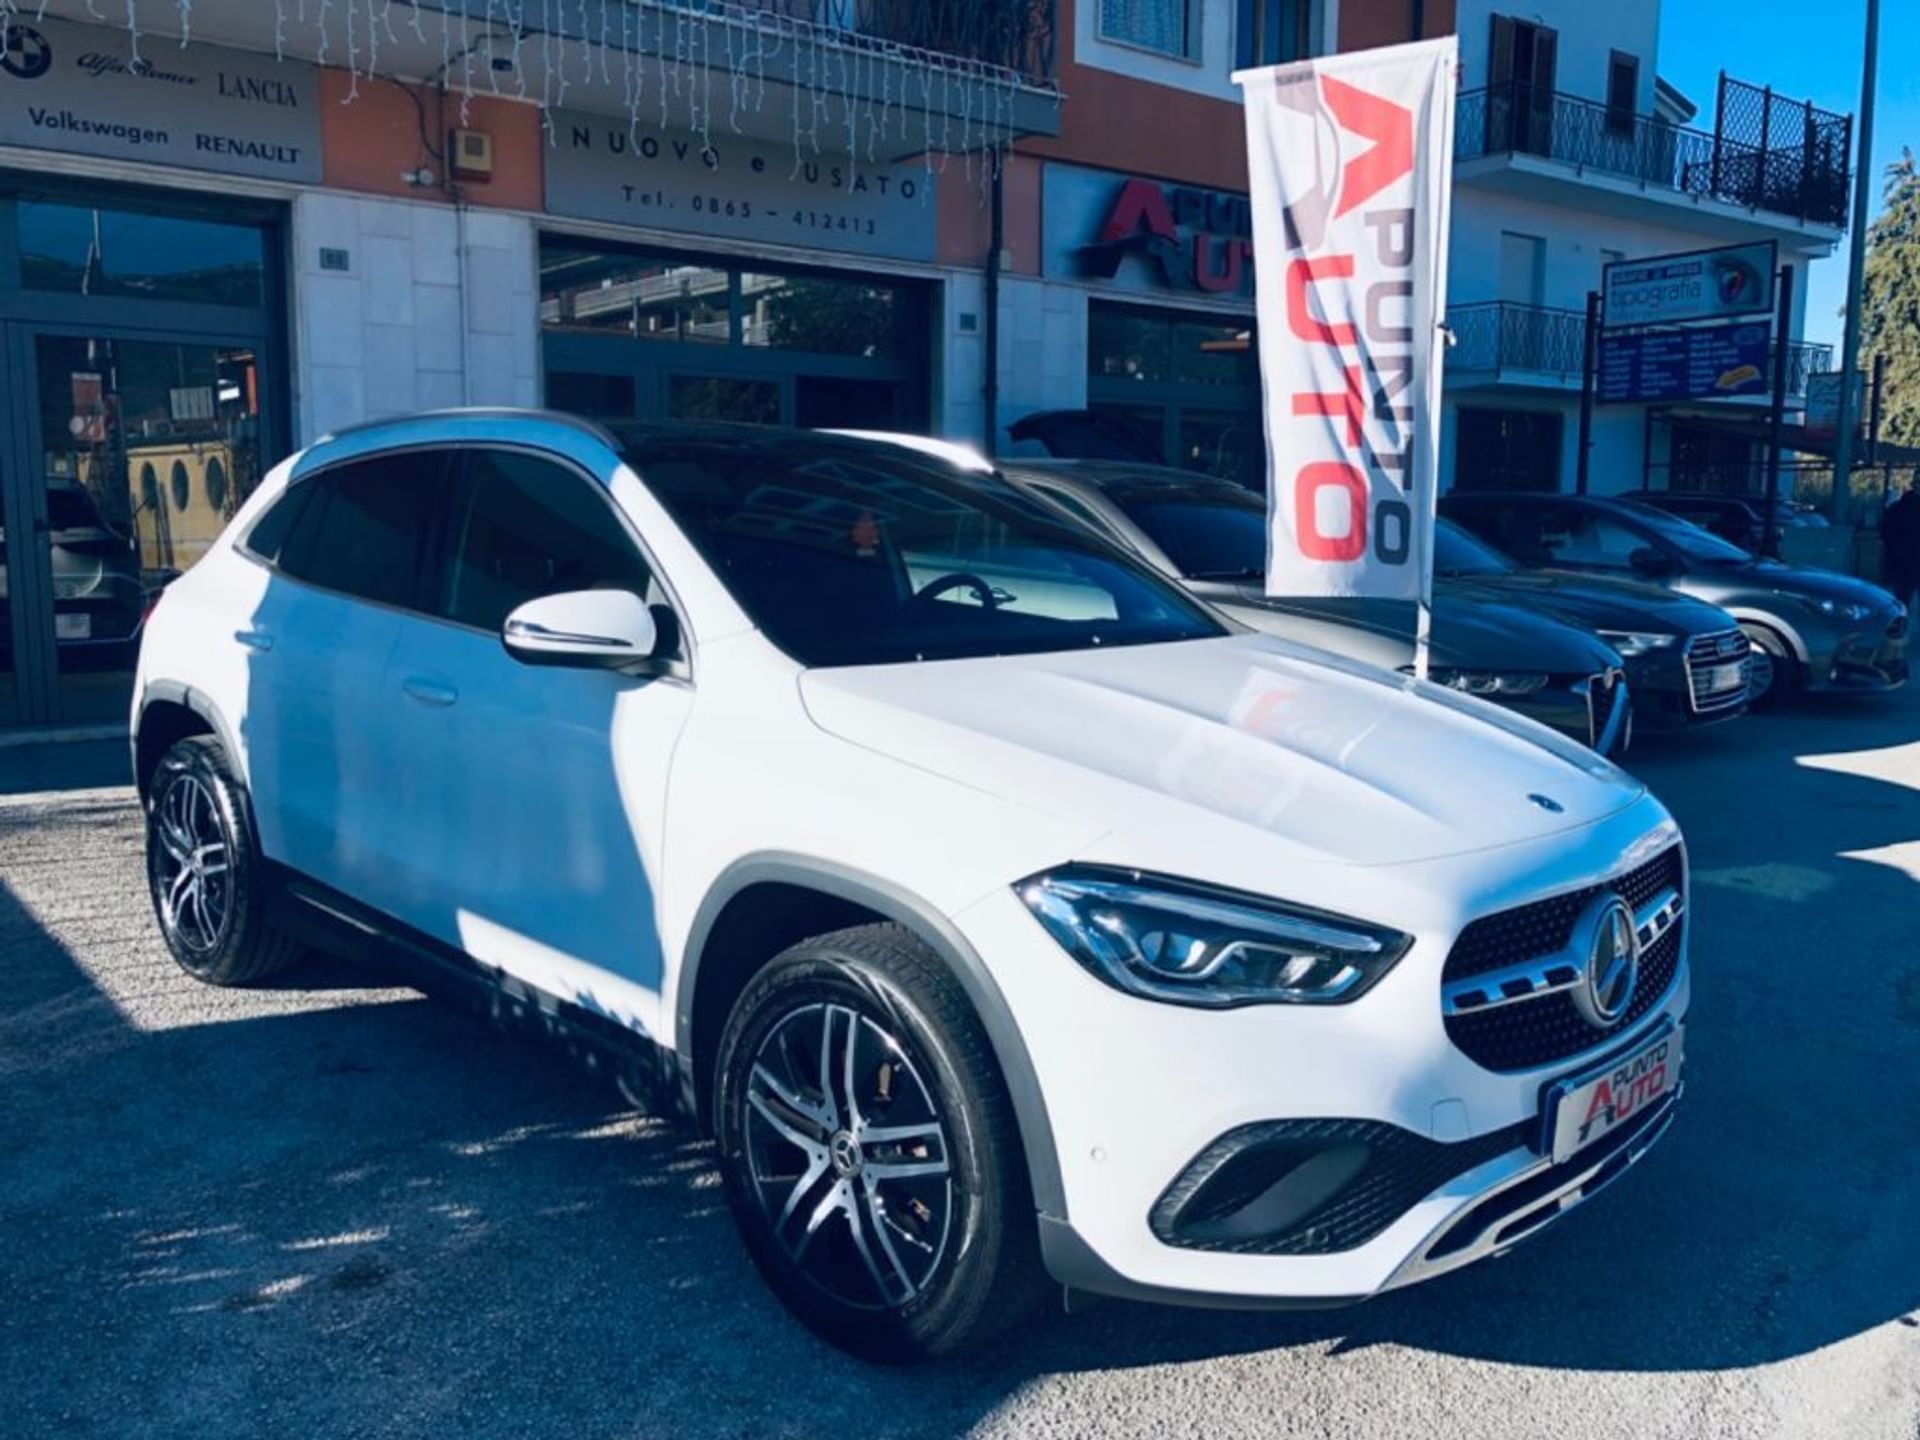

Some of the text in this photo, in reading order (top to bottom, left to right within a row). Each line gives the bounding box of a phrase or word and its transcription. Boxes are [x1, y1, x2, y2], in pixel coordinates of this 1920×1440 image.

[217, 72, 298, 107] LANCIA
[28, 107, 301, 164] Volkswagen RENAULT
[572, 126, 916, 198] NUOVO e USATO
[621, 184, 675, 208] Tel.
[691, 195, 751, 218] 0865
[793, 211, 876, 235] 412413
[1364, 206, 1415, 566] PUNTO
